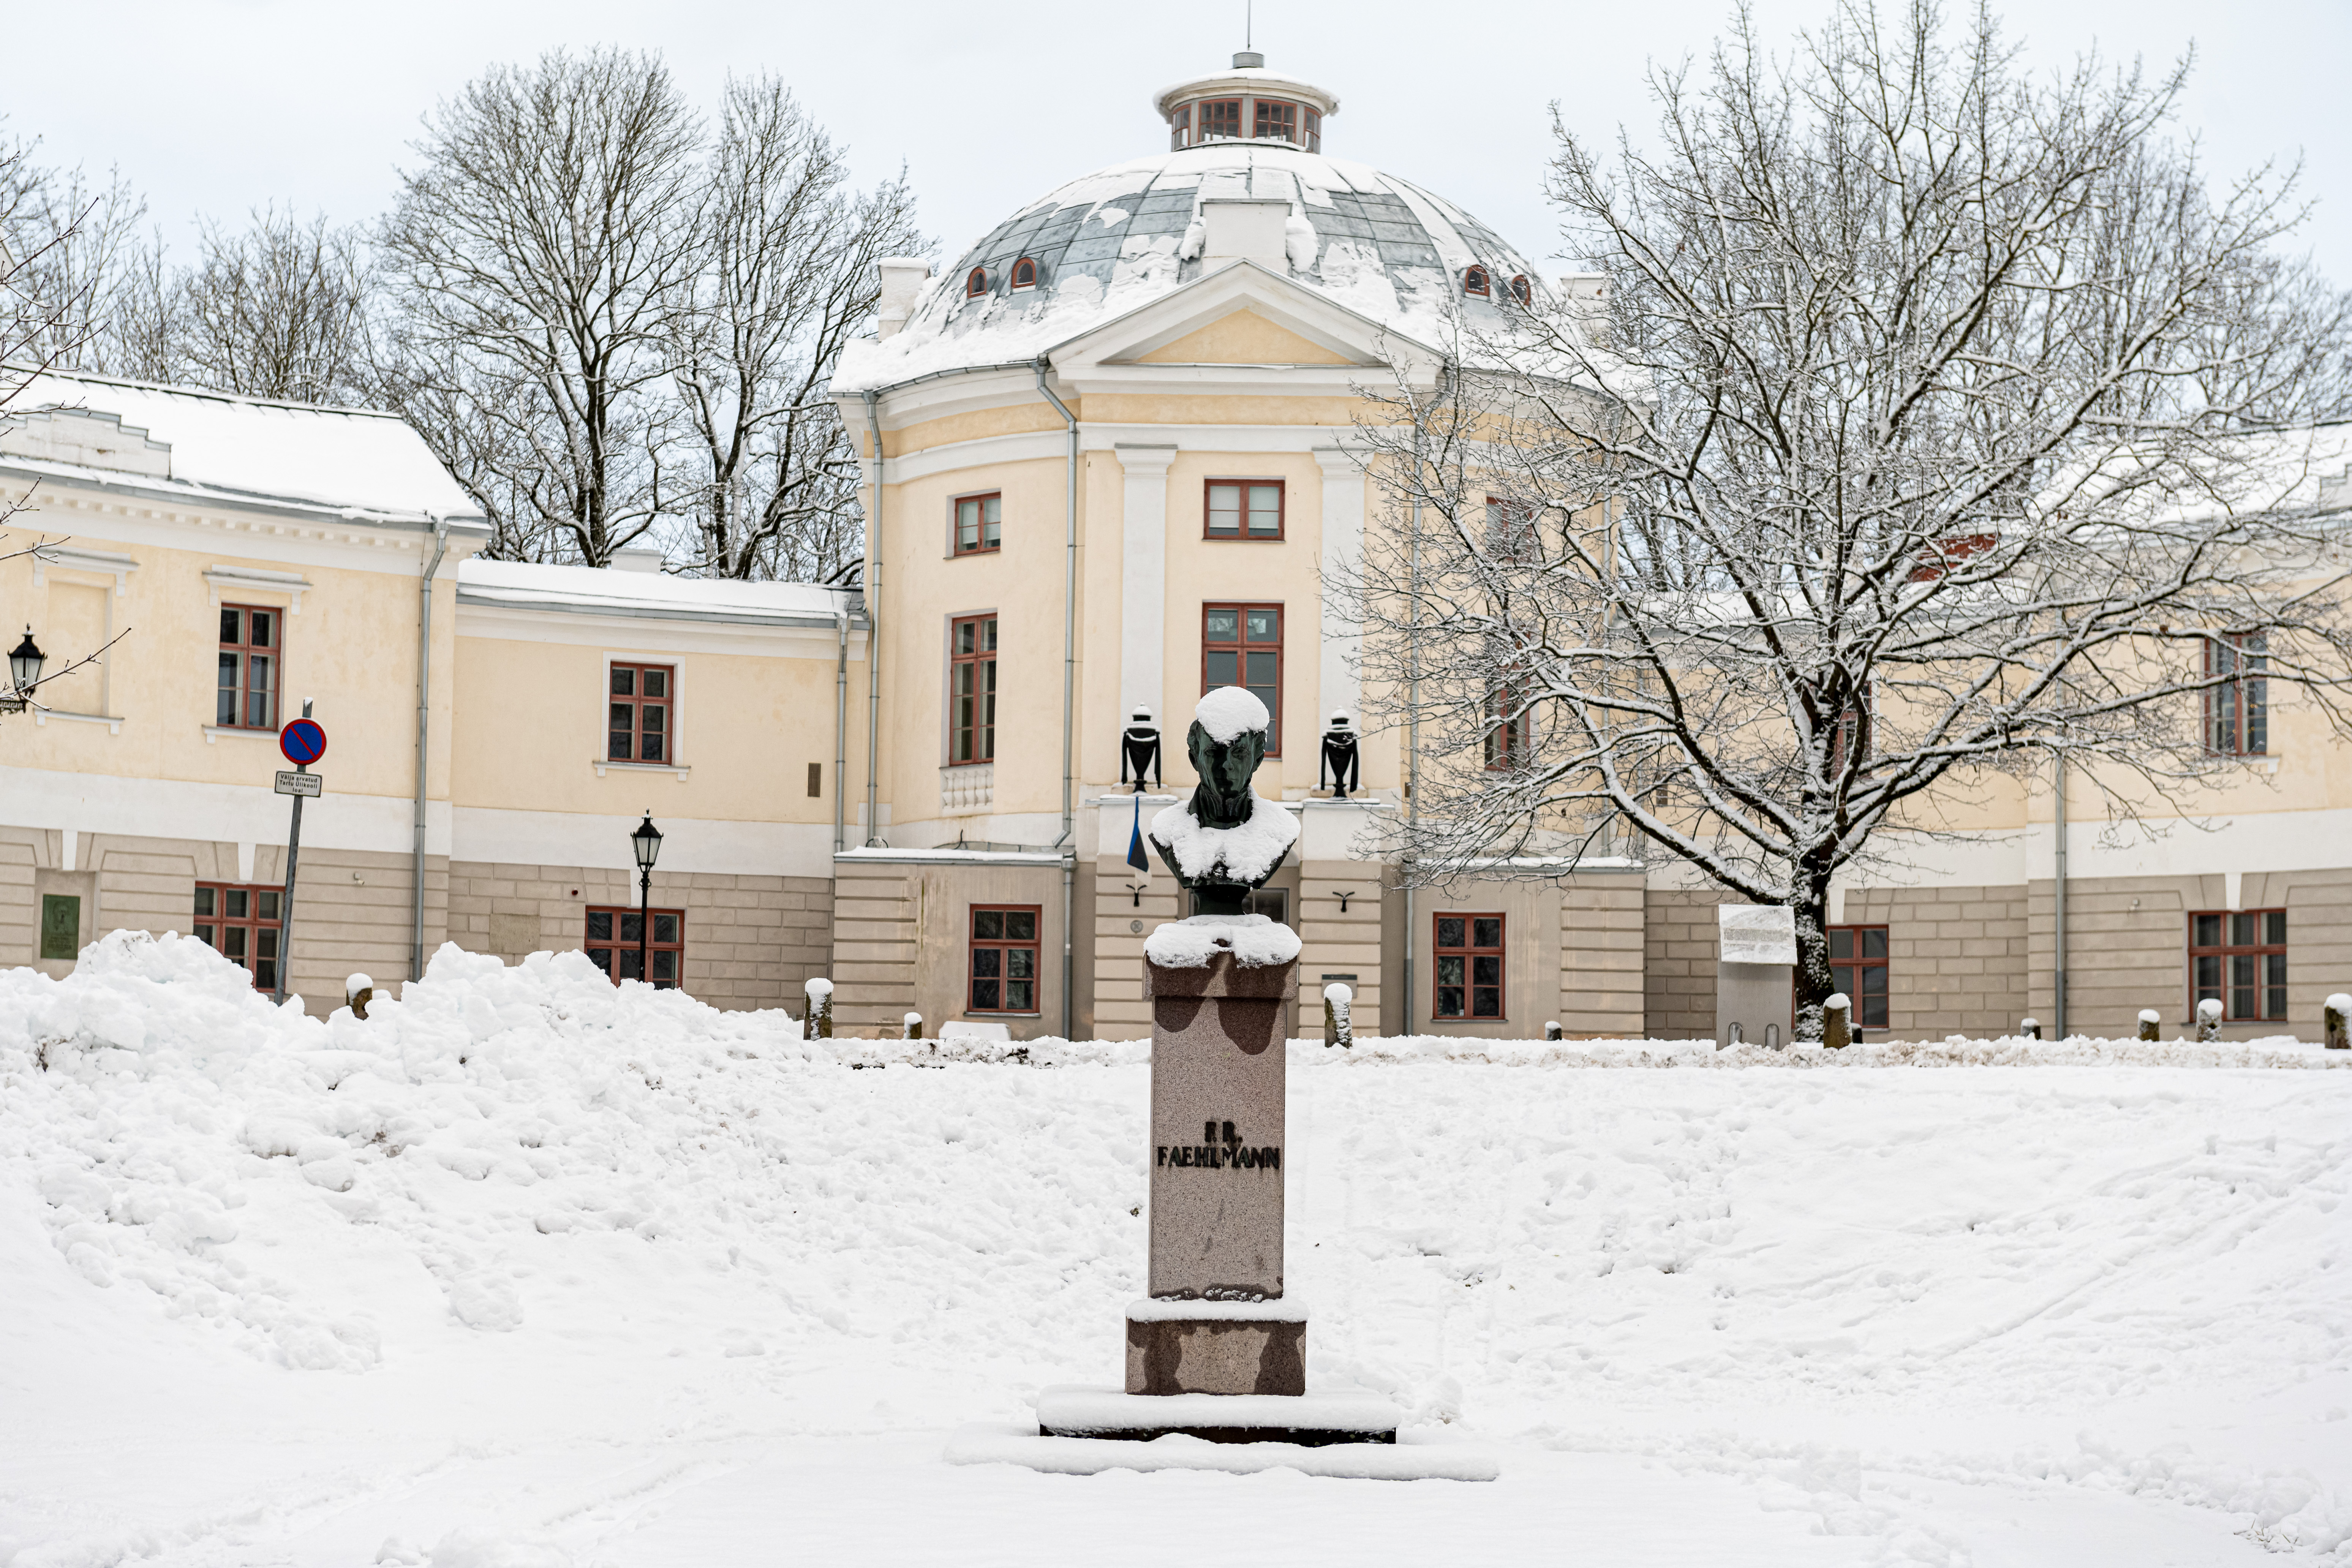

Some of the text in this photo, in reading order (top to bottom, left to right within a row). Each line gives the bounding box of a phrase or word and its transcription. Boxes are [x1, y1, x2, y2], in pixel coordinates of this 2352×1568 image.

[1205, 1121, 1243, 1143] F. R.
[1157, 1146, 1280, 1168] FAEHLMANN
